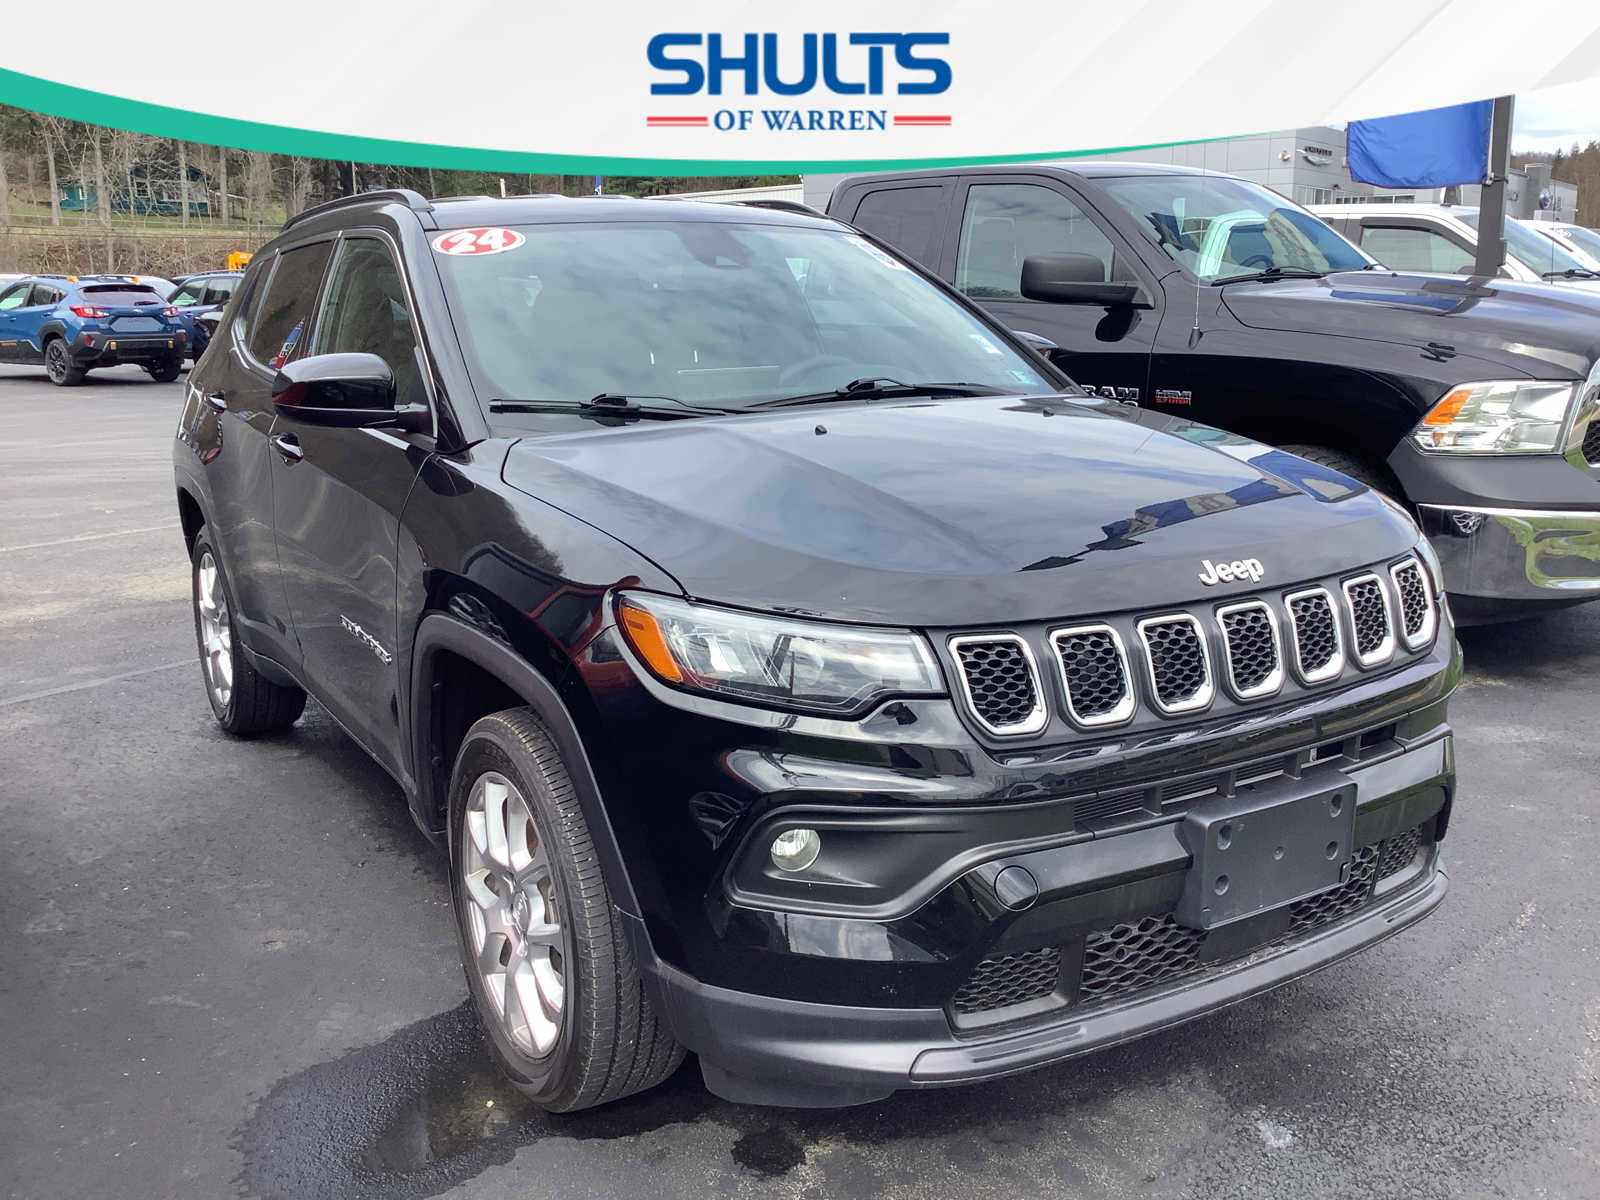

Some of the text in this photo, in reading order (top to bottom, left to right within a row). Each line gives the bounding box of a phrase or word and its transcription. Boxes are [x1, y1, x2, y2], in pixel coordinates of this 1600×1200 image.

[447, 229, 508, 252] 24
[1080, 384, 1139, 400] RAM
[1199, 558, 1264, 585] Jeep
